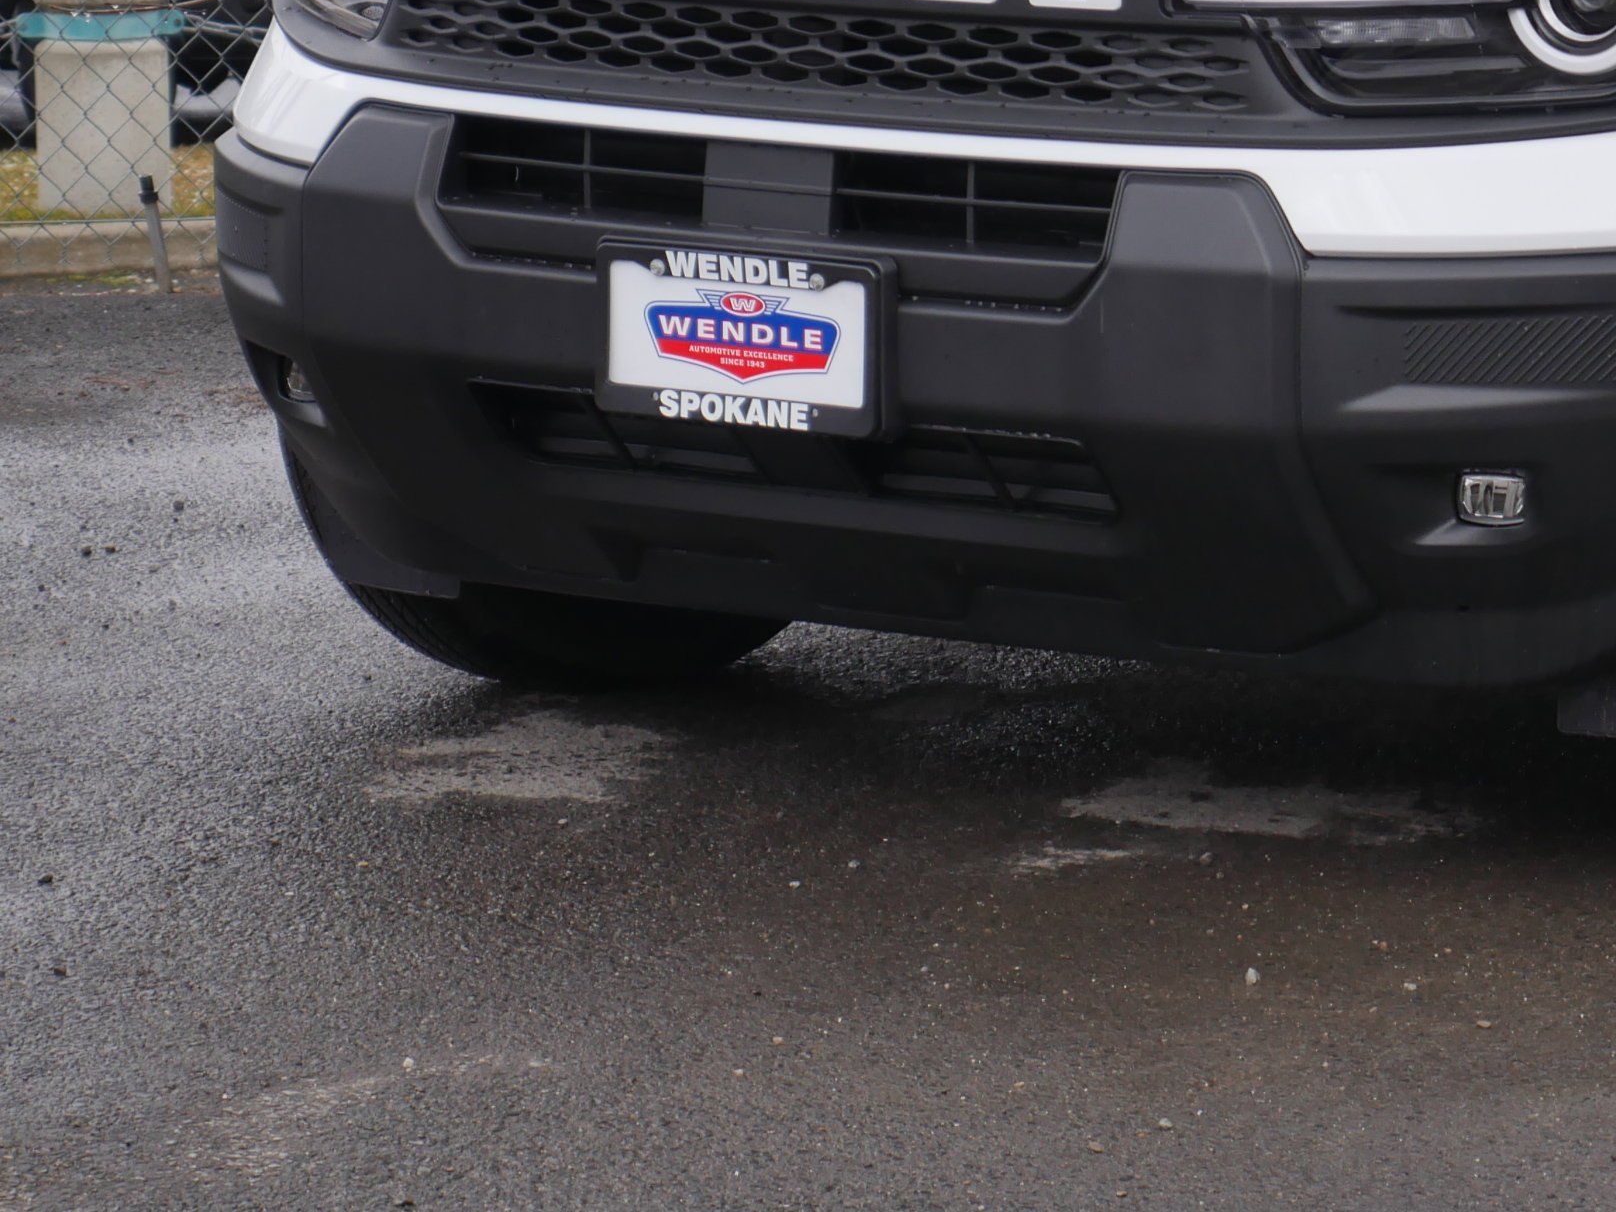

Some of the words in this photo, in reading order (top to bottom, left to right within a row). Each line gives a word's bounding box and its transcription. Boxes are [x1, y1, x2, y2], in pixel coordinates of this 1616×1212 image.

[665, 250, 809, 289] WENDLE
[658, 314, 822, 350] WENDLE
[689, 344, 740, 357] AUTOMOTIVE
[743, 350, 794, 362] EXCELLENCE
[720, 357, 744, 367] SINCE
[746, 360, 765, 368] 1943
[658, 389, 809, 431] SPOKANE
